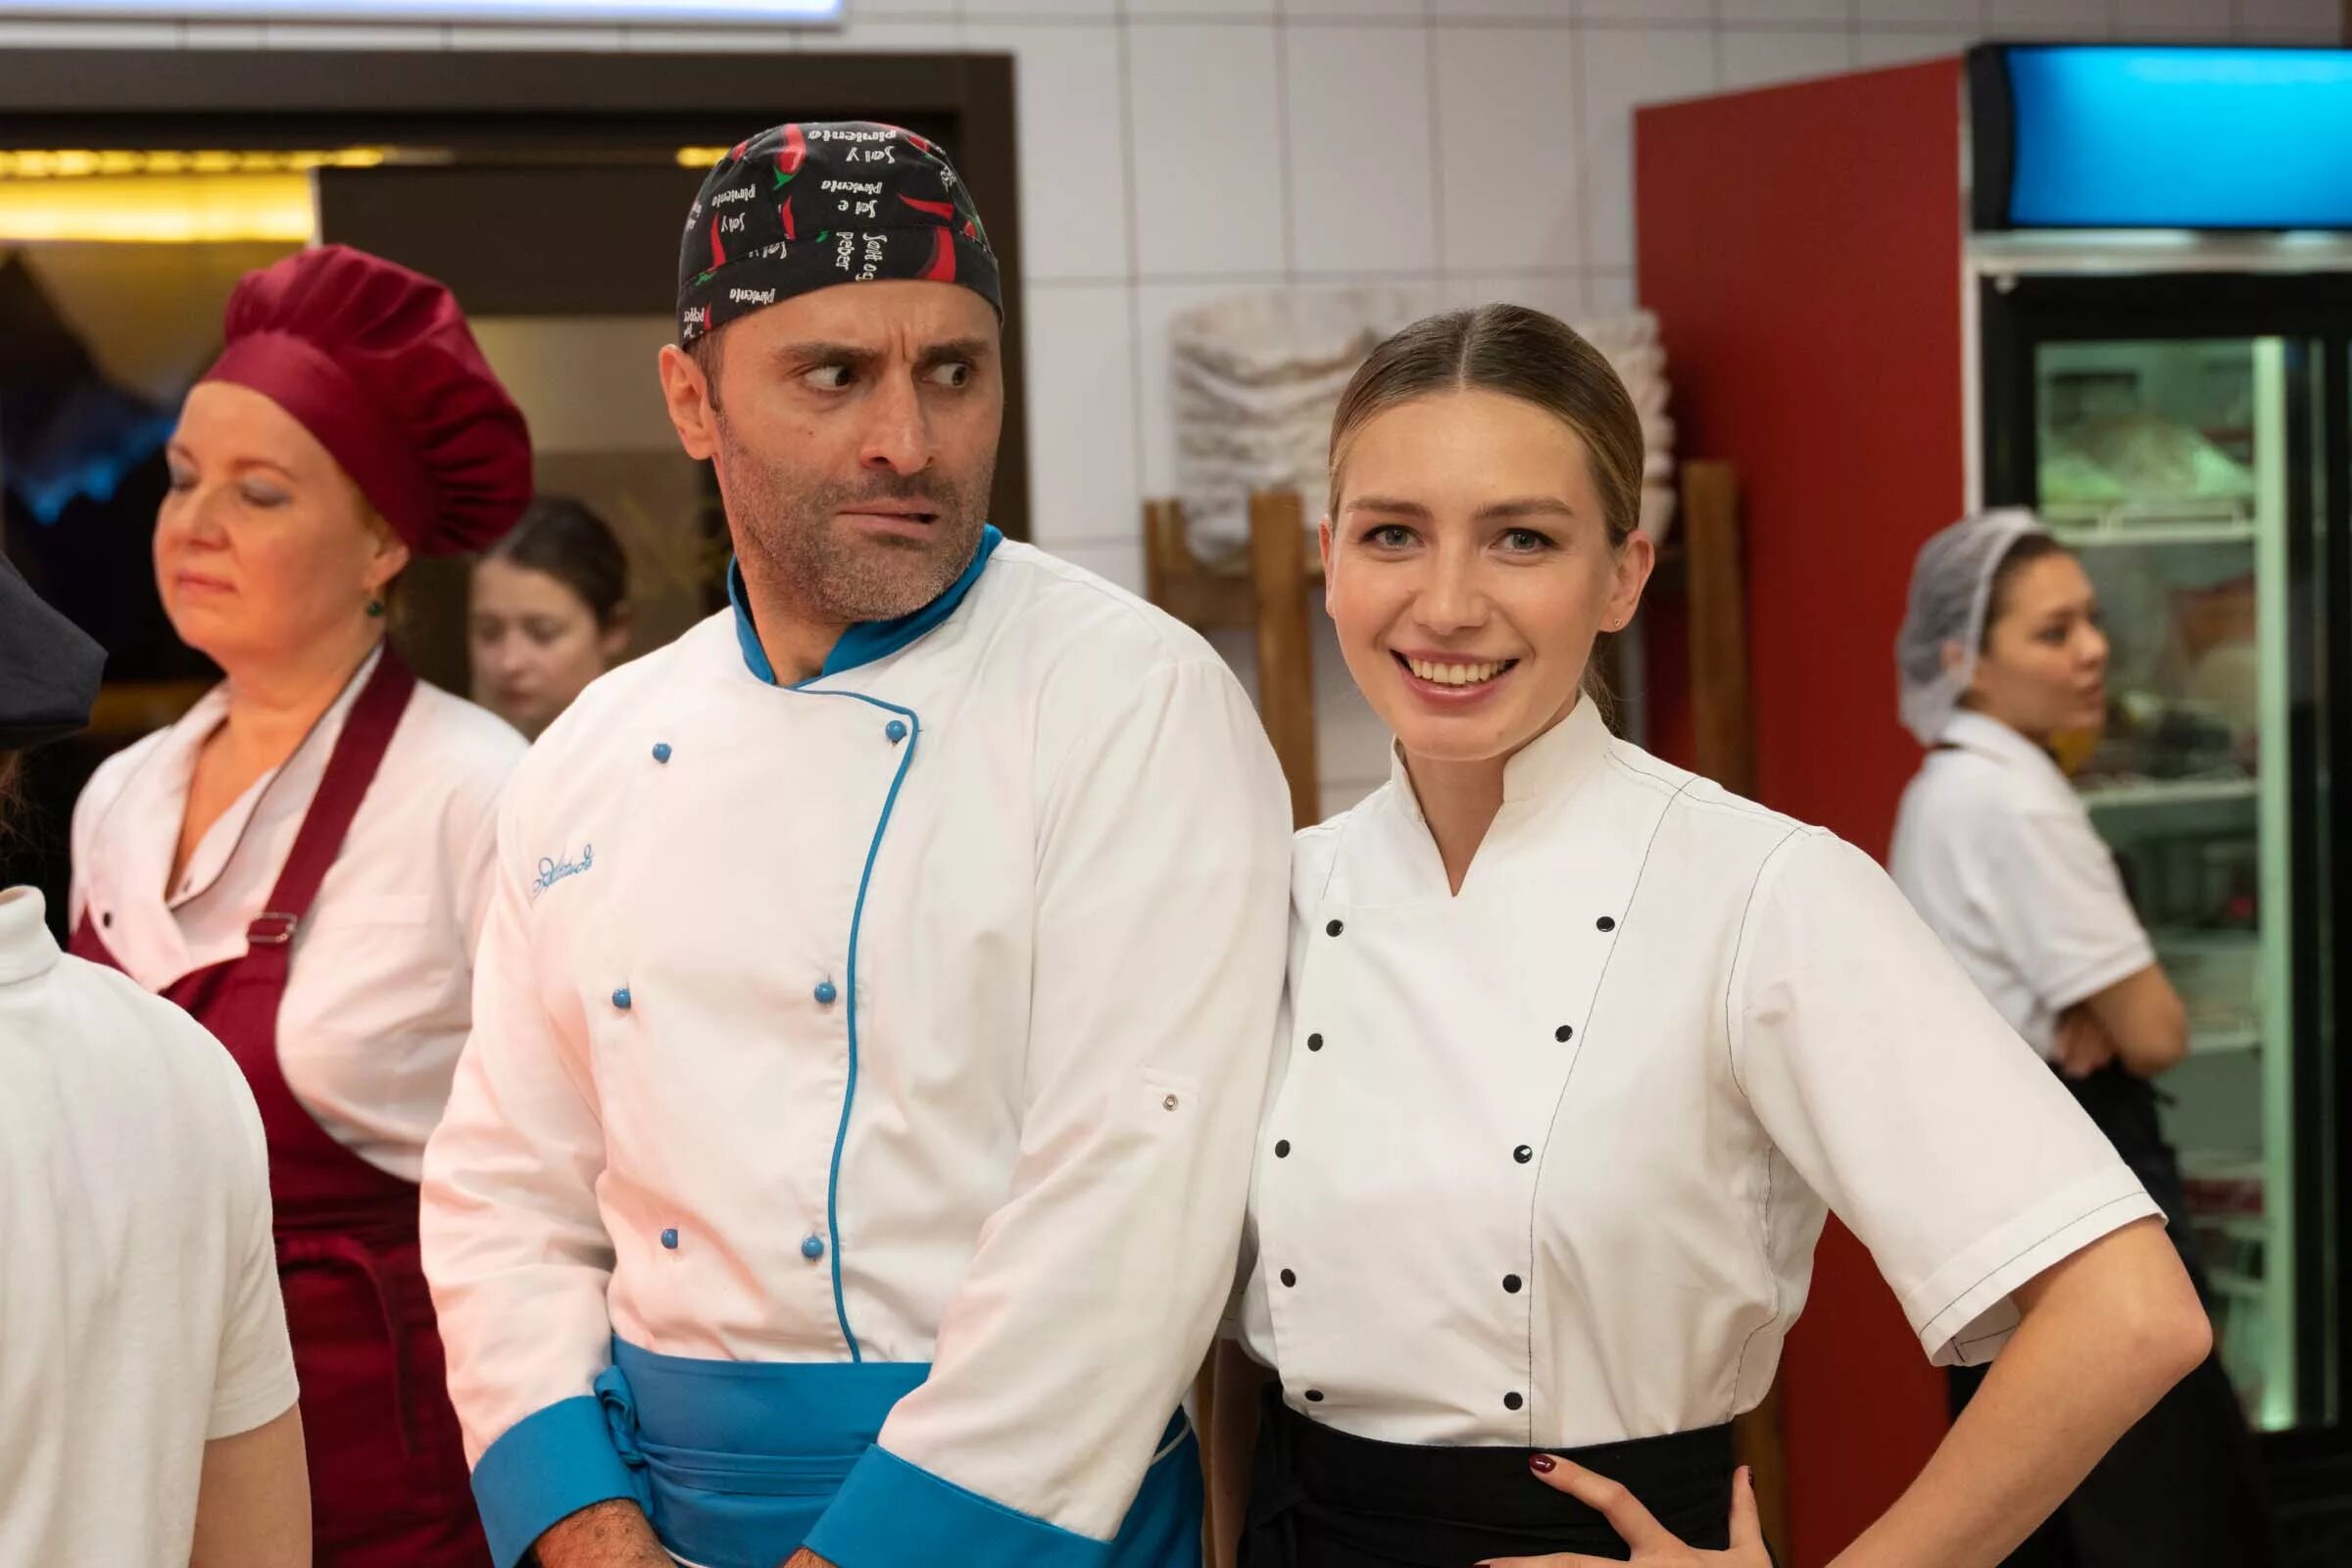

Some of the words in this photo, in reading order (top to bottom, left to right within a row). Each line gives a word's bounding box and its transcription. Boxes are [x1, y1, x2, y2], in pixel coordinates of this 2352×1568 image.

[821, 179, 883, 195] pimienta
[837, 199, 850, 212] e
[836, 231, 855, 271] peber
[862, 232, 888, 262] Salt
[856, 263, 876, 282] og
[729, 287, 777, 306] pimienta
